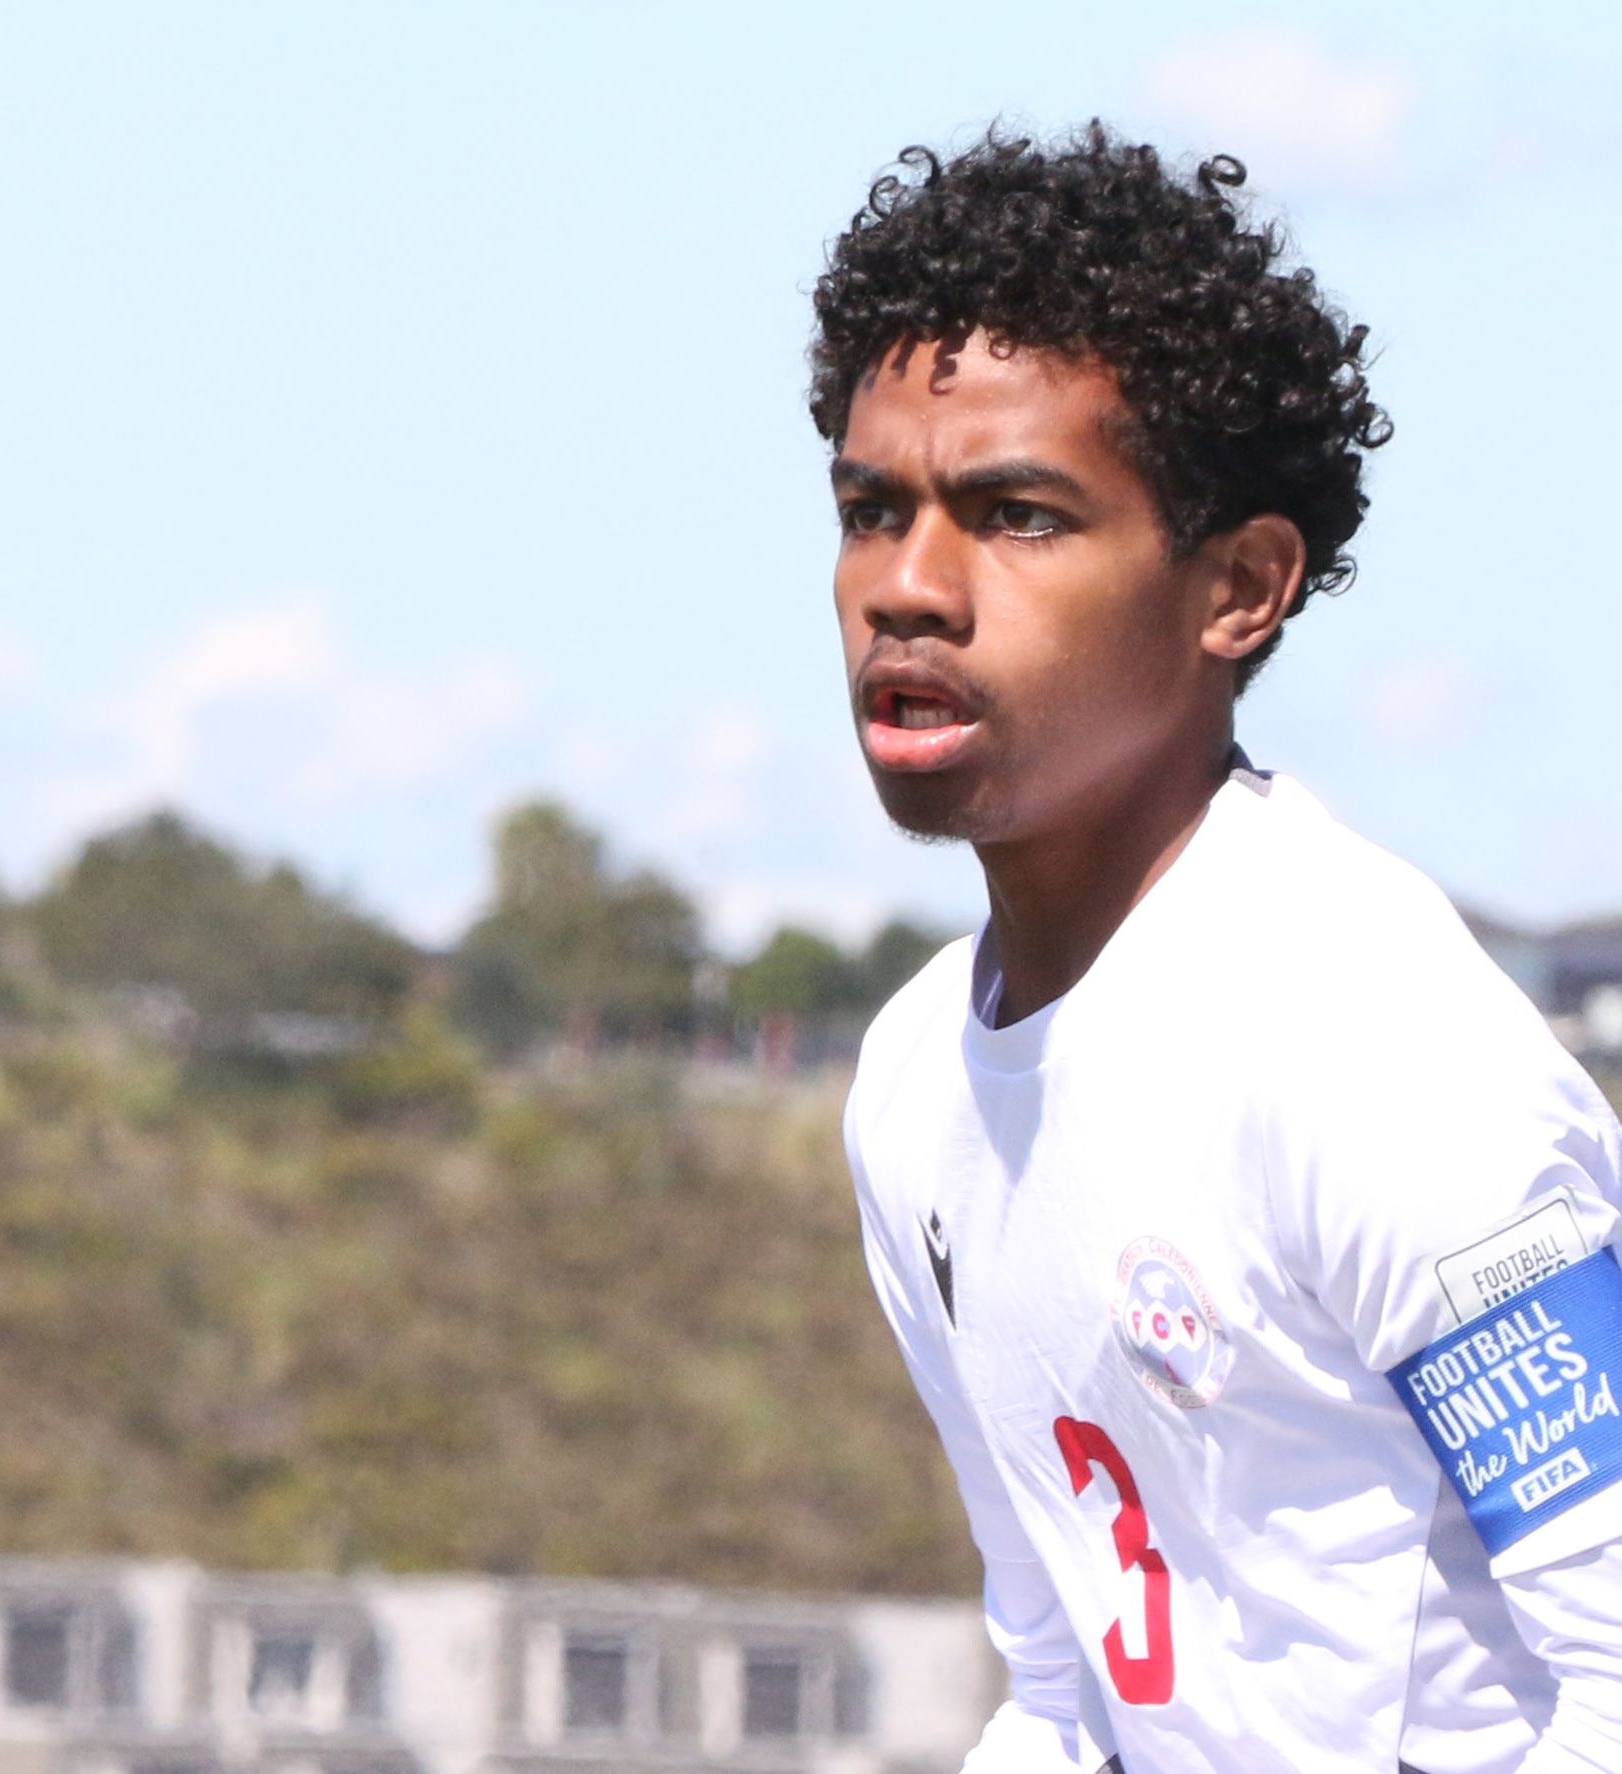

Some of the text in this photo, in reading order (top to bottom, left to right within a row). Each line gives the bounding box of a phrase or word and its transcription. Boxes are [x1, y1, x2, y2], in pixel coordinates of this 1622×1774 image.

[1471, 1233, 1564, 1295] FOOTBALL
[1407, 1299, 1563, 1407] FOOTBALL
[1427, 1332, 1588, 1451] UNITES
[1455, 1371, 1621, 1498] the World
[1521, 1456, 1582, 1504] FIFA
[1053, 1415, 1175, 1705] 3
